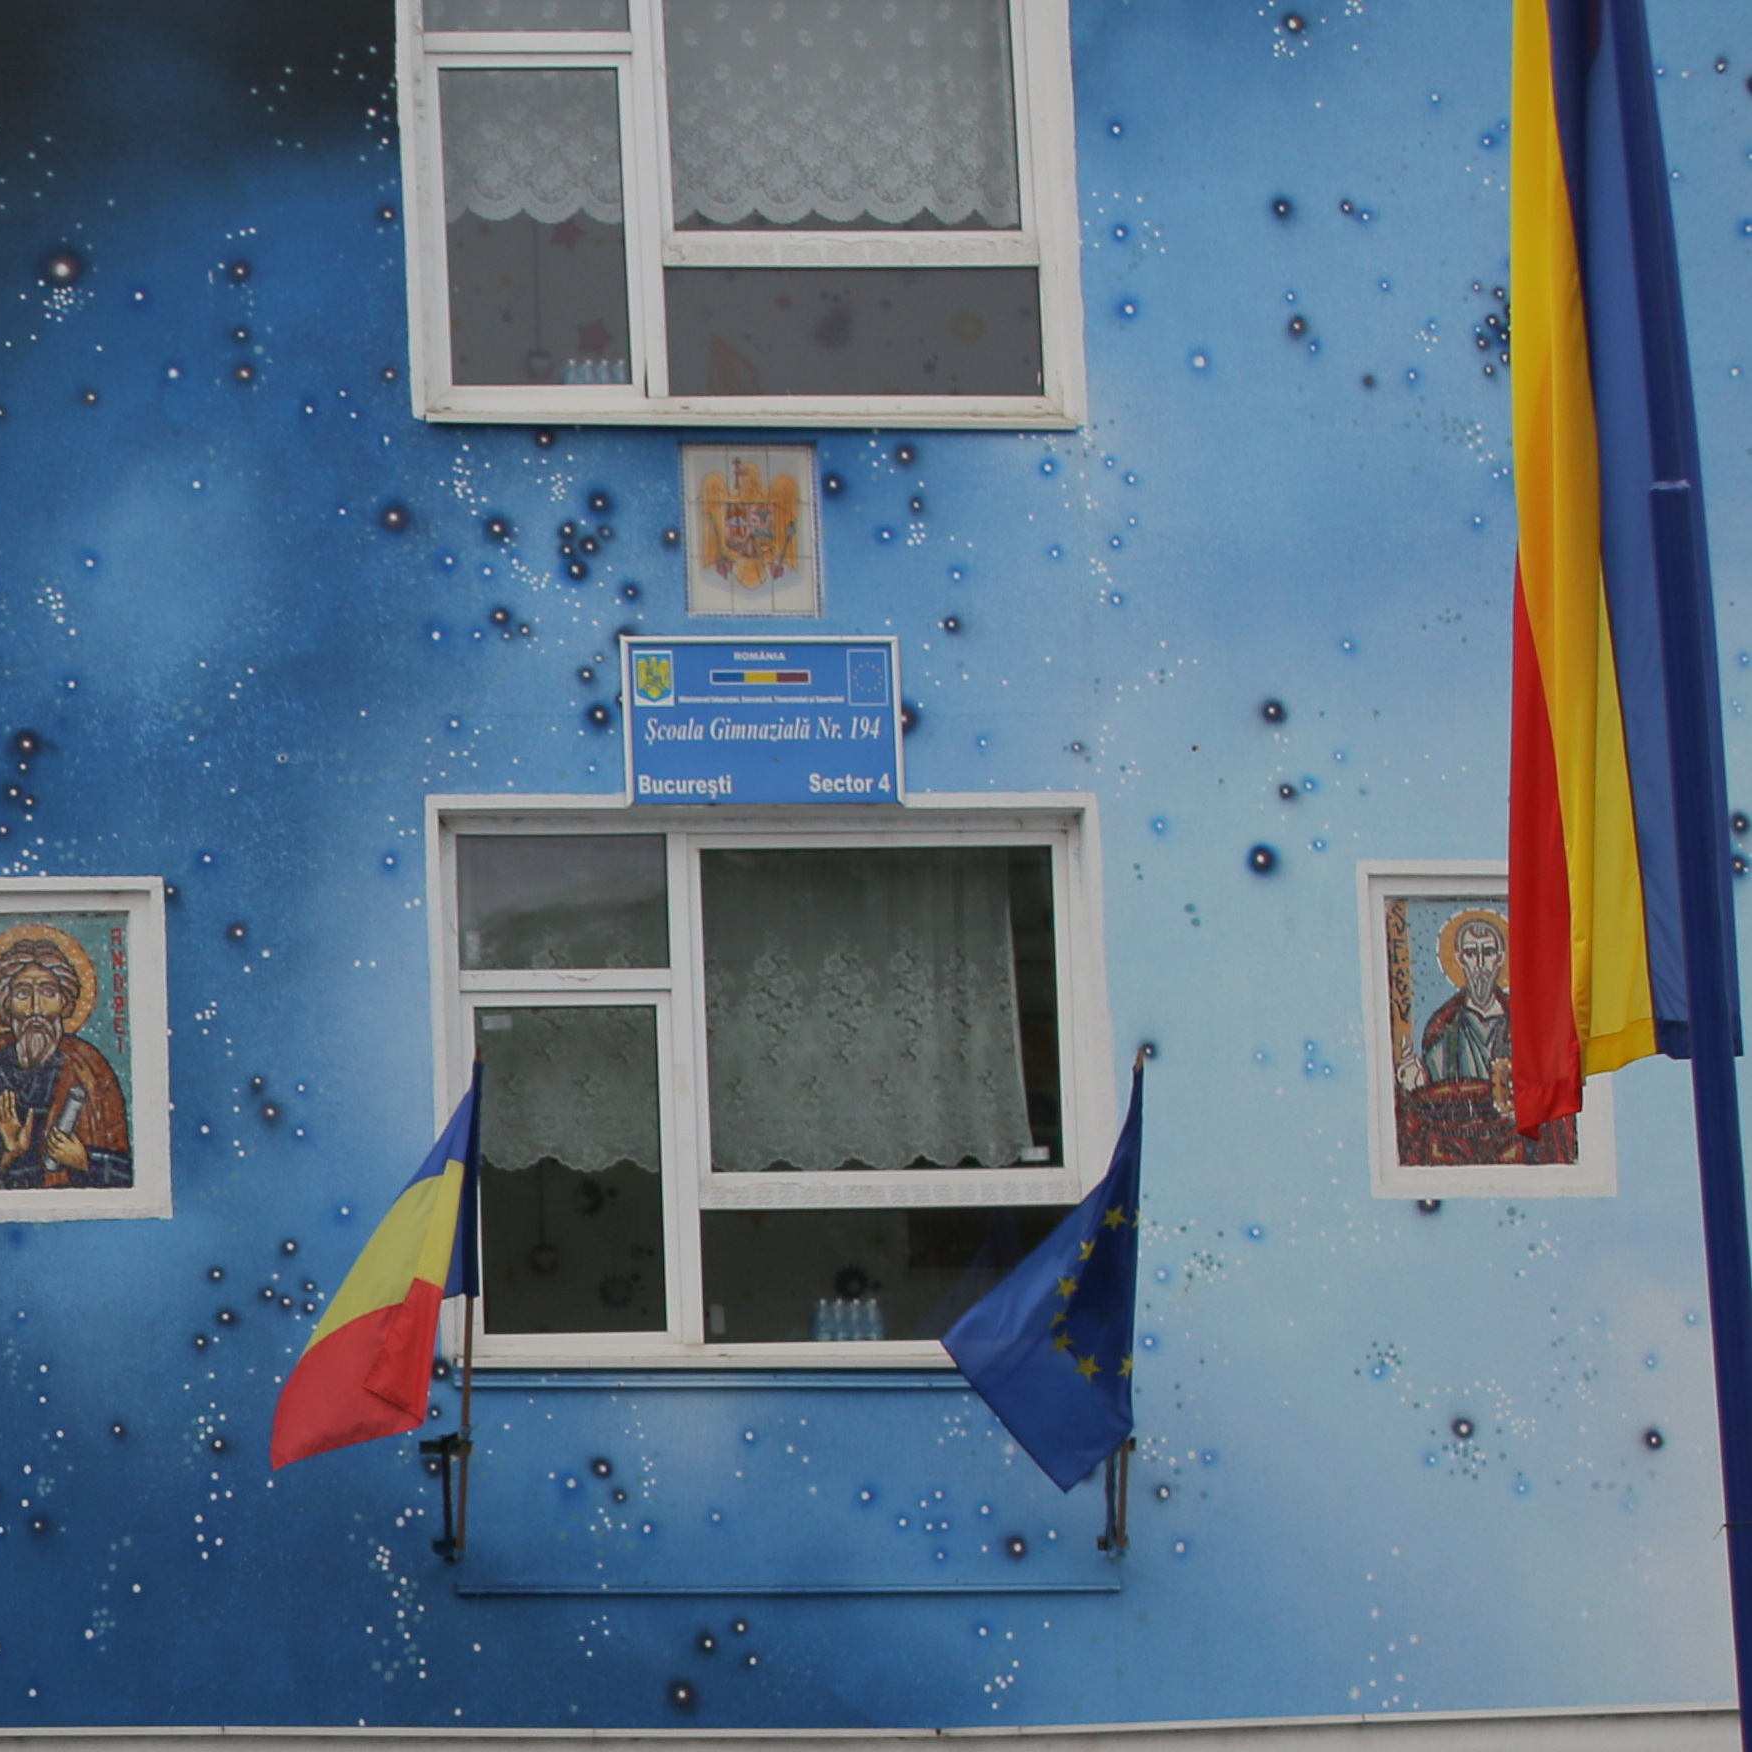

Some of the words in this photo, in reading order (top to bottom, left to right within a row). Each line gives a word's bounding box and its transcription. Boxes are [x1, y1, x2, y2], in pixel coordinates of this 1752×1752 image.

[710, 716, 811, 742] Gimnazială
[816, 716, 843, 740] Nr.
[849, 716, 881, 740] 194
[808, 772, 874, 793] Sector
[877, 773, 892, 793] 4
